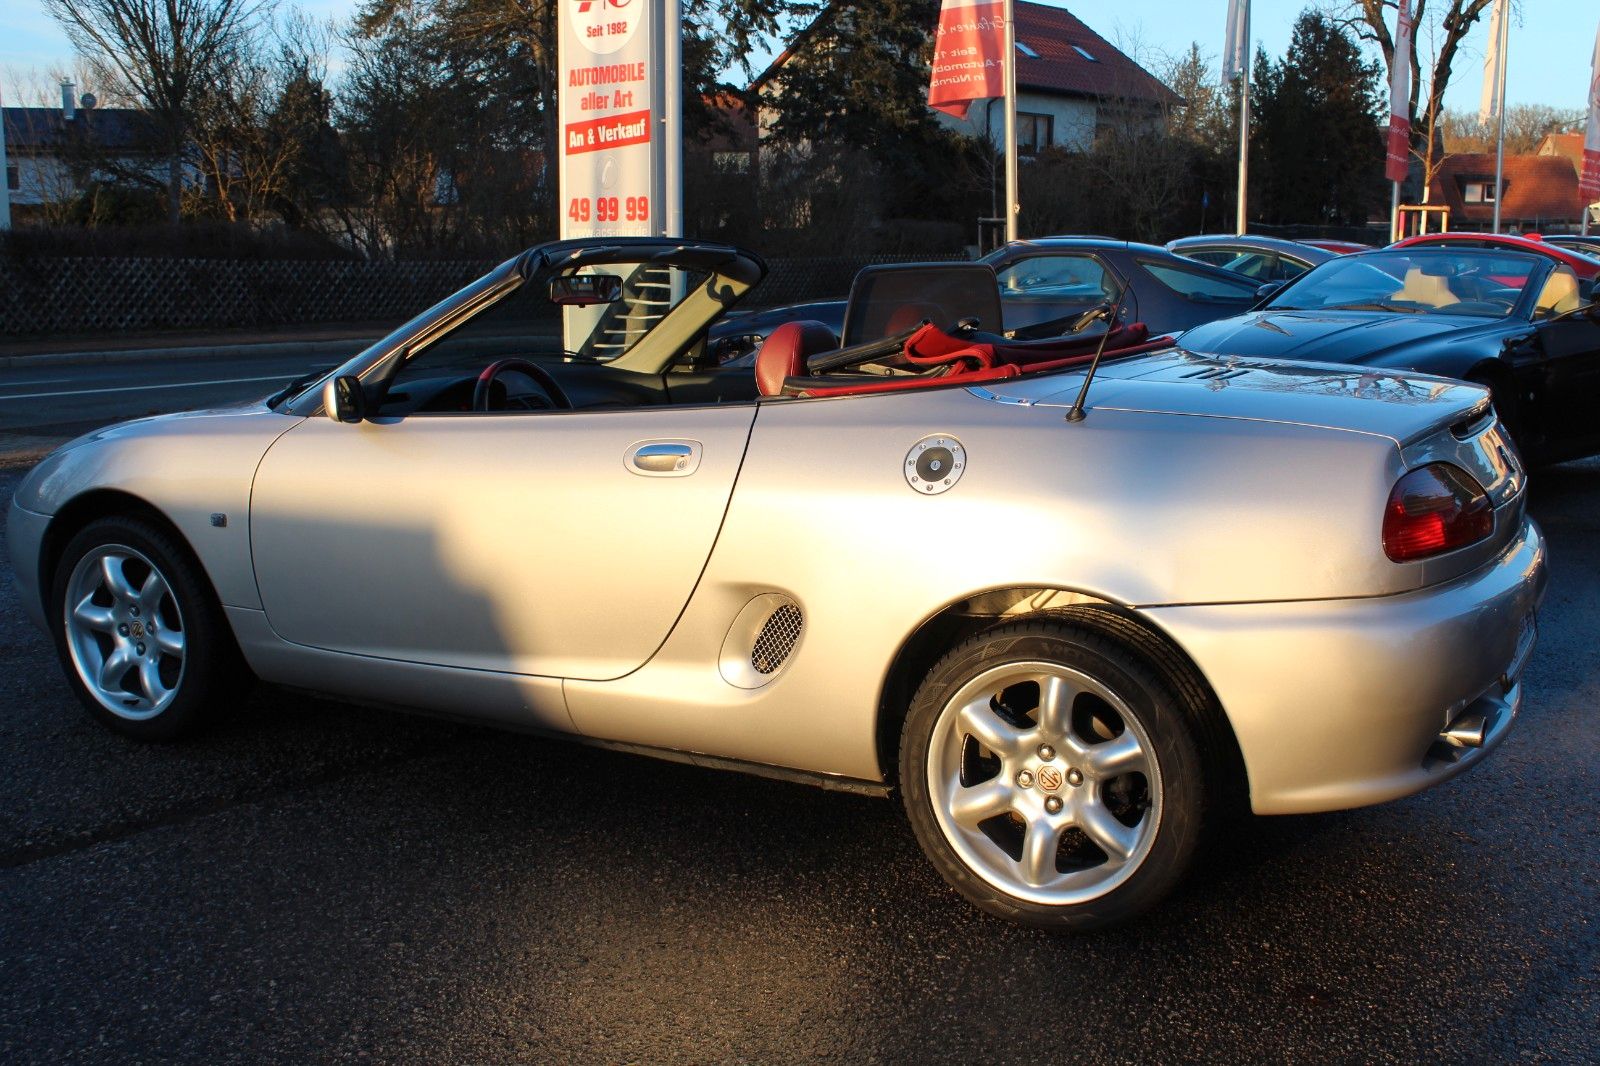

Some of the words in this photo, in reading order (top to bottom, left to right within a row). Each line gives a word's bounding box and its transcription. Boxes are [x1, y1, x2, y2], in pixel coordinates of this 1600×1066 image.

[586, 24, 603, 37] Seit
[606, 21, 627, 36] 1982
[568, 62, 645, 87] AUTOMOBILE
[580, 91, 609, 111] aller
[613, 89, 633, 108] Art
[569, 130, 584, 148] An
[587, 128, 595, 145] &
[597, 119, 646, 143] Verkauf
[568, 198, 590, 222] 49
[596, 197, 618, 222] 99
[626, 196, 648, 221] 99
